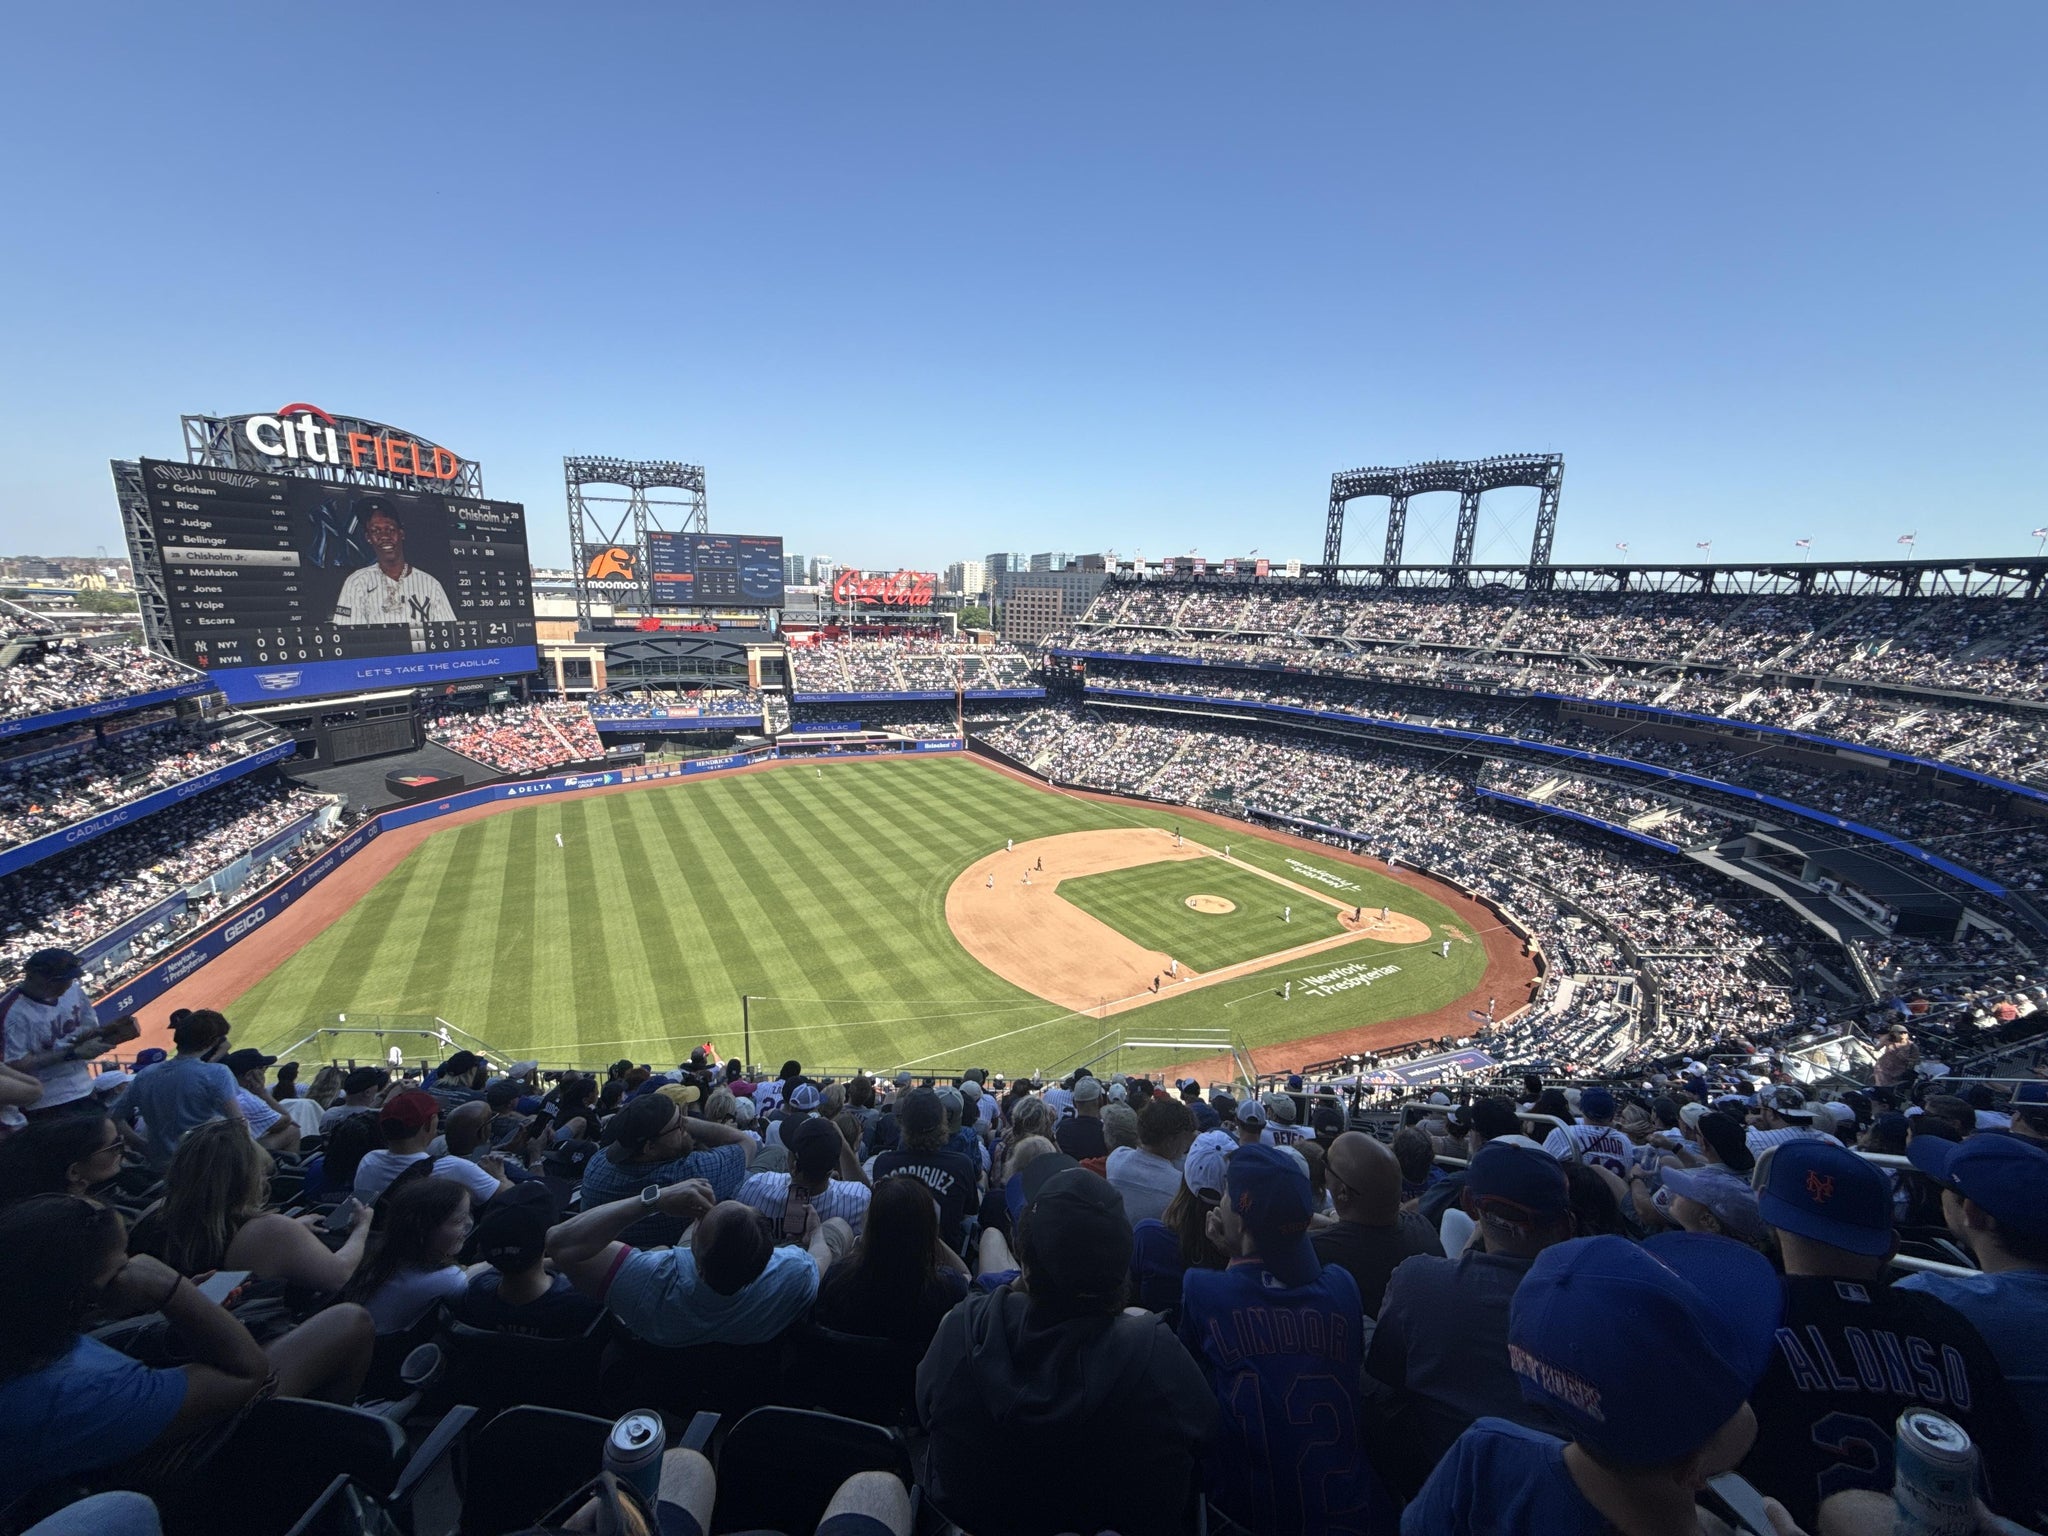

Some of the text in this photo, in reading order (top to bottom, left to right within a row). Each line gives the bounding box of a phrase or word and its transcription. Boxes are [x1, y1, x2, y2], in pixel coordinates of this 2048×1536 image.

[246, 405, 459, 480] citi FIELD
[173, 484, 216, 496] Grisham
[176, 501, 200, 511] Rice
[448, 505, 456, 513] 13
[458, 508, 500, 523] Chisholm
[500, 513, 512, 524] Jr.
[180, 517, 212, 529] Judge
[183, 535, 227, 547] Bellinger
[186, 552, 232, 562] Chisholm
[235, 553, 248, 562] Jr.
[189, 568, 239, 577] McMahon
[192, 585, 223, 593] Jones
[587, 580, 639, 591] moomoo
[195, 601, 225, 611] Volpe
[460, 599, 474, 607] .301
[479, 599, 494, 607] .350
[198, 617, 235, 625] Escarra
[218, 641, 238, 649] NYY
[256, 638, 266, 648] 0
[277, 637, 286, 646] 0
[298, 636, 303, 645] 1
[315, 634, 323, 644] 0
[332, 633, 341, 643] 0
[428, 630, 435, 638] 2
[441, 629, 448, 637] 0
[459, 628, 465, 636] 3
[471, 628, 477, 636] 2
[489, 623, 507, 635] 2-1
[219, 656, 242, 664] NYM
[259, 652, 268, 662] 0
[279, 651, 288, 661] 0
[298, 649, 307, 659] 0
[318, 648, 324, 657] 1
[334, 647, 343, 657] 0
[430, 642, 436, 650] 6
[443, 640, 450, 649] 0
[356, 658, 501, 678] LET'S TAKE THE CADILLAC
[177, 684, 206, 695] CADILLAC
[457, 683, 484, 691] moomoo
[90, 700, 128, 714] CADILLAC
[805, 724, 849, 732] CADILLAC
[255, 745, 288, 764] CADILLAC
[696, 757, 734, 767] HENDRICK'S
[177, 773, 221, 797] CADILLAC
[518, 783, 552, 793] DELTA
[66, 811, 129, 843] CADILLAC
[1284, 858, 1354, 886] Presbyterian
[224, 906, 266, 942] GEICO
[168, 949, 198, 972] NewYork-
[169, 952, 208, 981] Presbyterian
[1303, 963, 1368, 987] NewYork-
[1318, 964, 1402, 995] Presbyterian
[117, 995, 134, 1012] 358
[1580, 1135, 1625, 1156] LINDOR
[1209, 1306, 1349, 1365] LINDOR
[1775, 1325, 1972, 1412] ALONSO
[1231, 1371, 1370, 1536] 12
